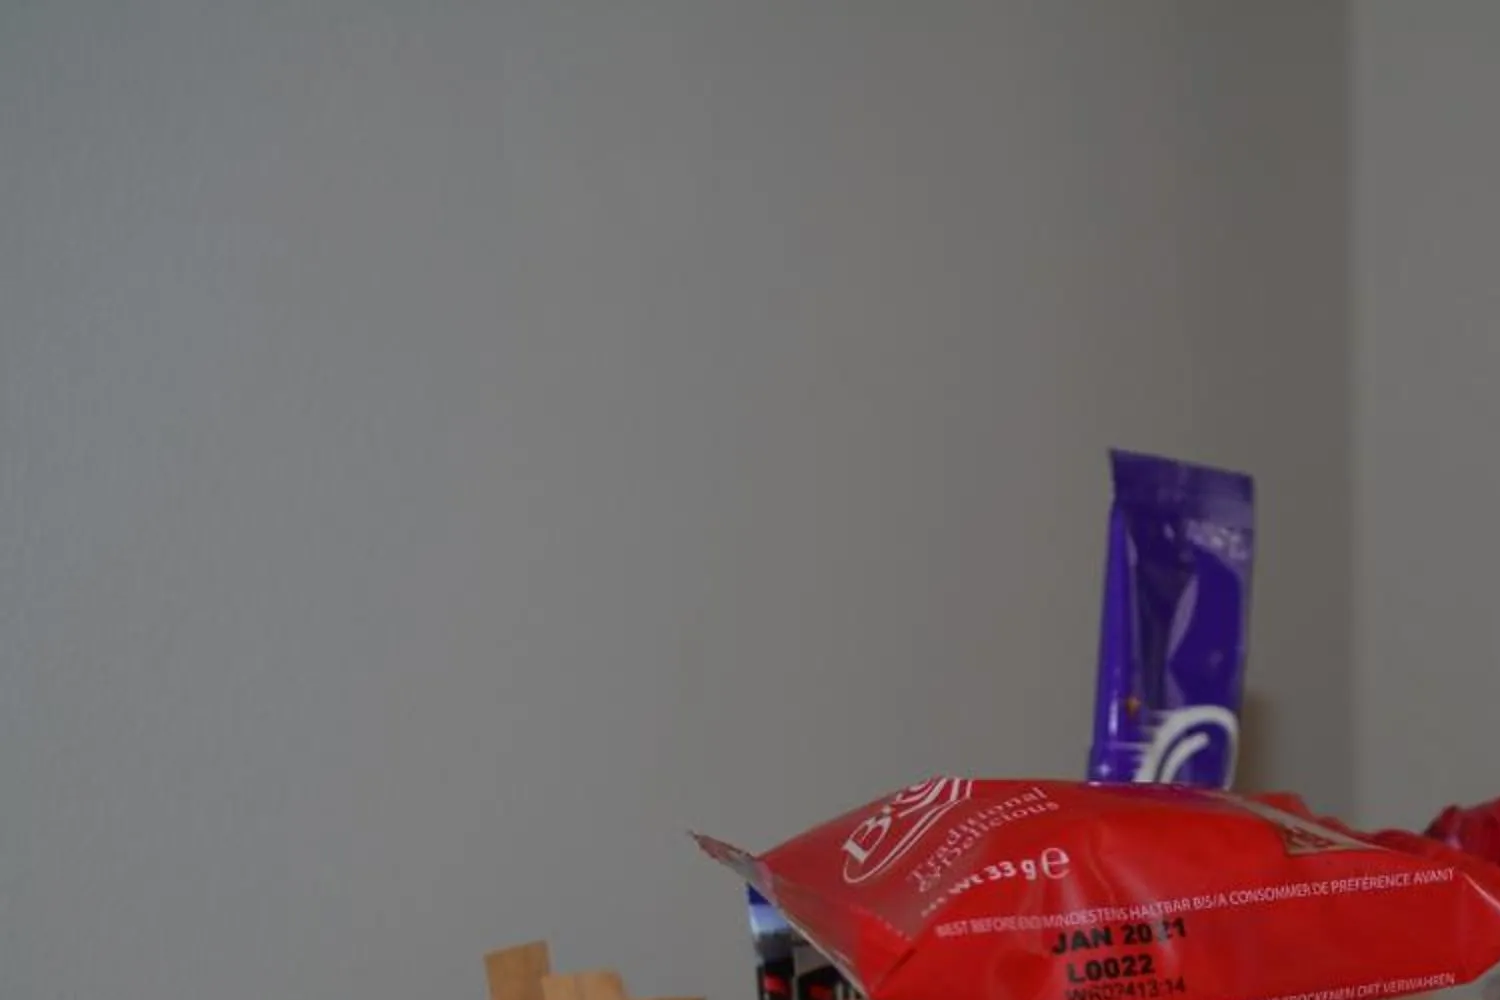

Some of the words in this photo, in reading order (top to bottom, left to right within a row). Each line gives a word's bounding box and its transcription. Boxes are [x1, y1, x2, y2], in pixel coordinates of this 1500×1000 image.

[984, 859, 1017, 880] 33
[1313, 880, 1330, 897] DE
[1412, 866, 1456, 885] AVANT
[1052, 926, 1115, 955] JAN
[1067, 954, 1155, 984] L0022
